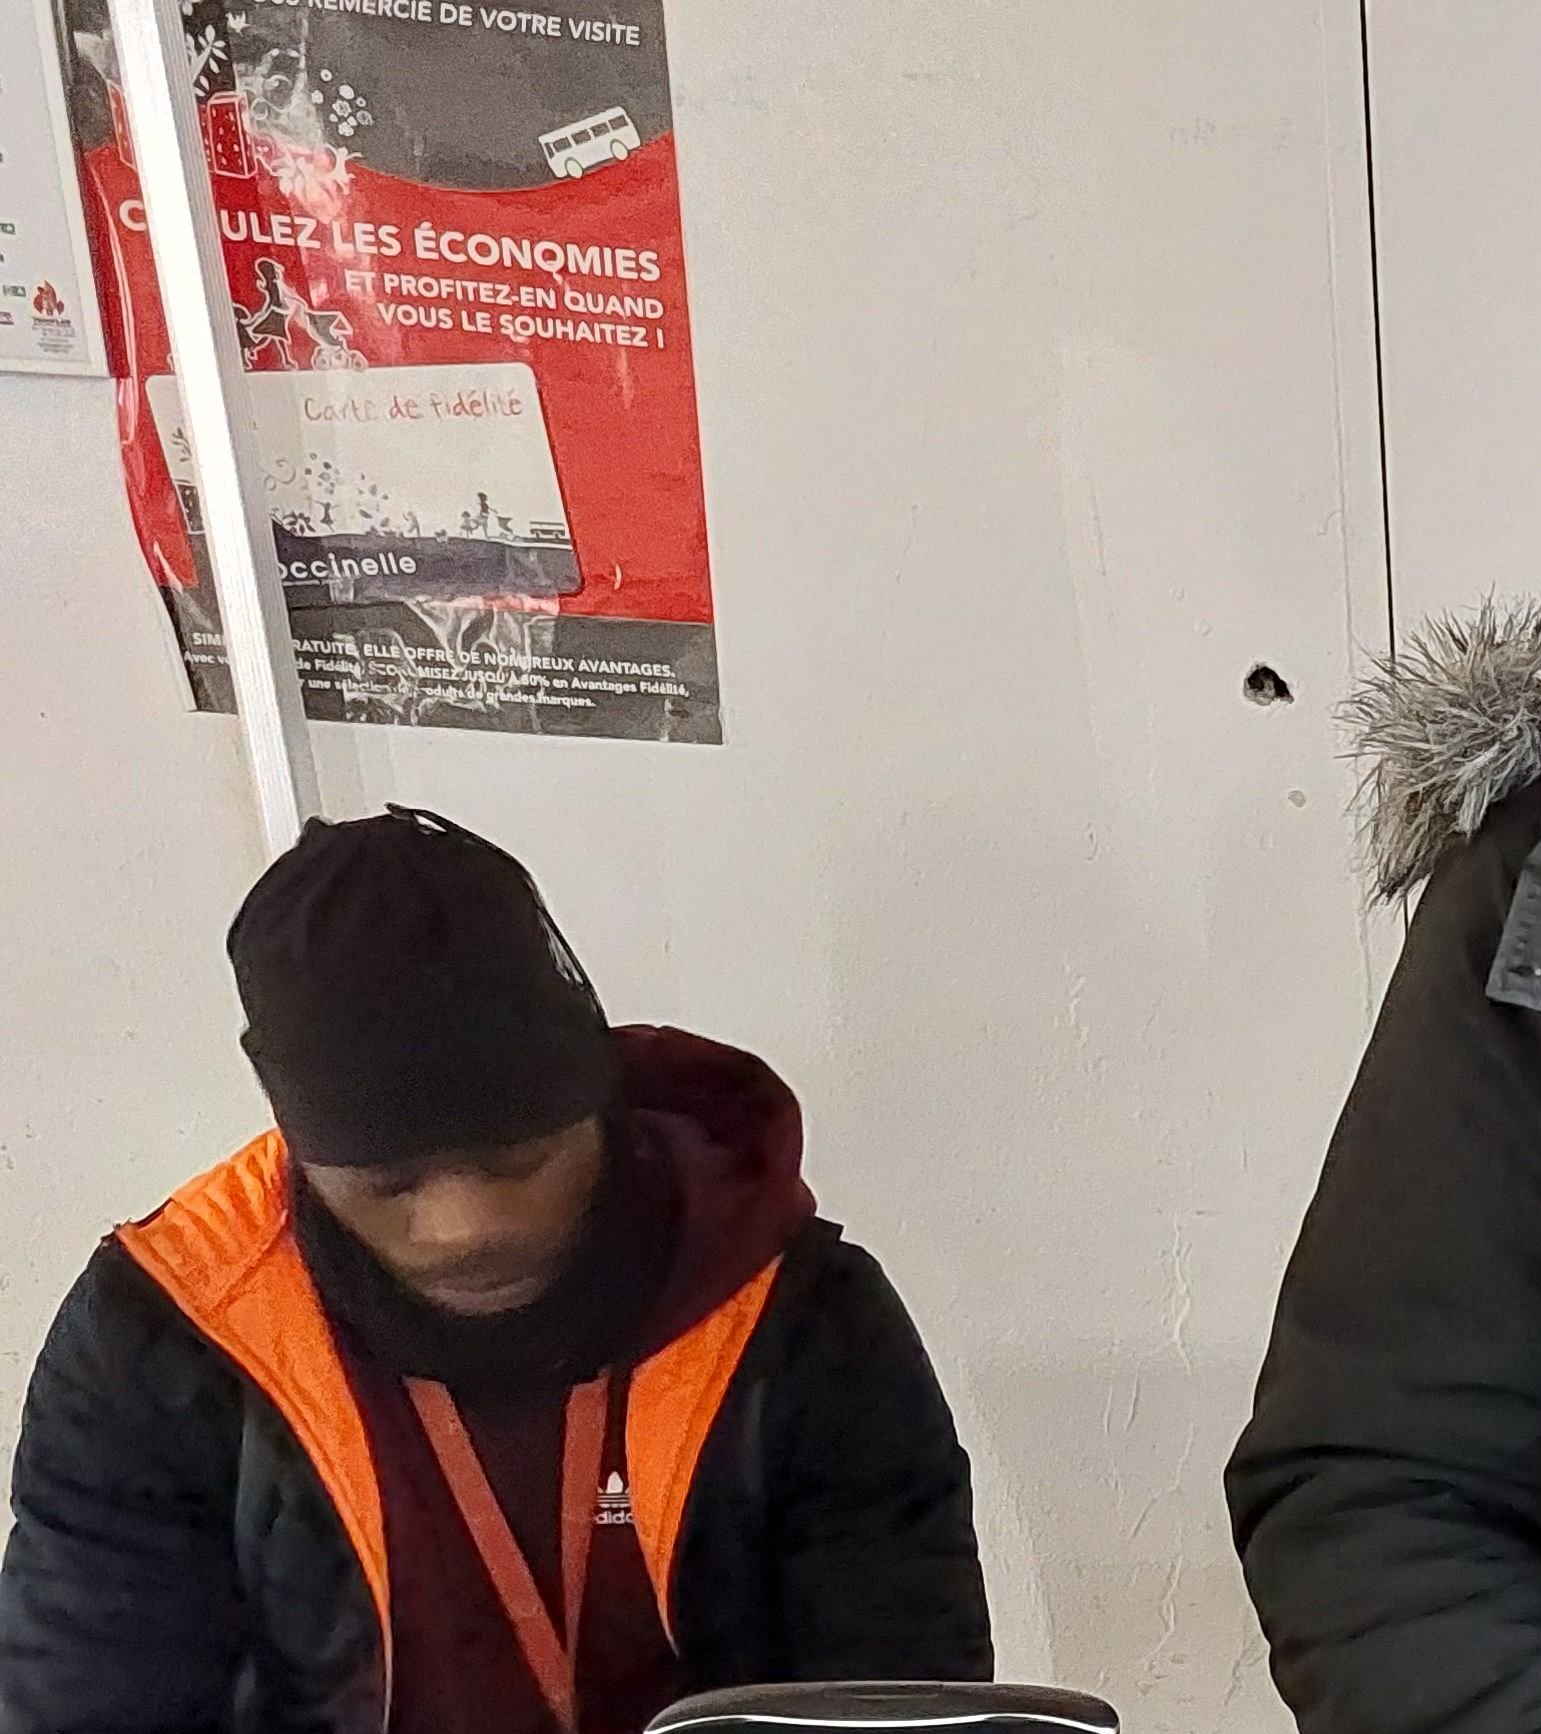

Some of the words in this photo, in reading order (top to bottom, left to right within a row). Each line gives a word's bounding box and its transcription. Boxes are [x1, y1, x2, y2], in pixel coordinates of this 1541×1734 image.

[439, 2, 473, 26] DE
[479, 7, 562, 37] VOTRE
[568, 17, 640, 46] VISITE
[119, 199, 321, 250] CULEZ
[332, 220, 401, 257] LES
[413, 221, 661, 281] ÉCONOMIES
[345, 269, 376, 293] ET
[384, 273, 556, 309] PROFITEZ-EN
[564, 291, 665, 319] QUAND
[376, 302, 453, 330] VOUS
[460, 310, 493, 334] LE
[500, 314, 648, 348] SOUHAITEZ
[389, 395, 424, 420] de
[430, 387, 523, 423] fidélité
[278, 552, 416, 580] occinelle
[363, 642, 401, 658] ELLE
[403, 646, 455, 662] OFFRE
[459, 650, 481, 665] DE
[578, 657, 676, 678] AVANTAGES.
[553, 680, 568, 690] en
[571, 680, 637, 695] Avantages
[640, 681, 690, 698] Fidélité,
